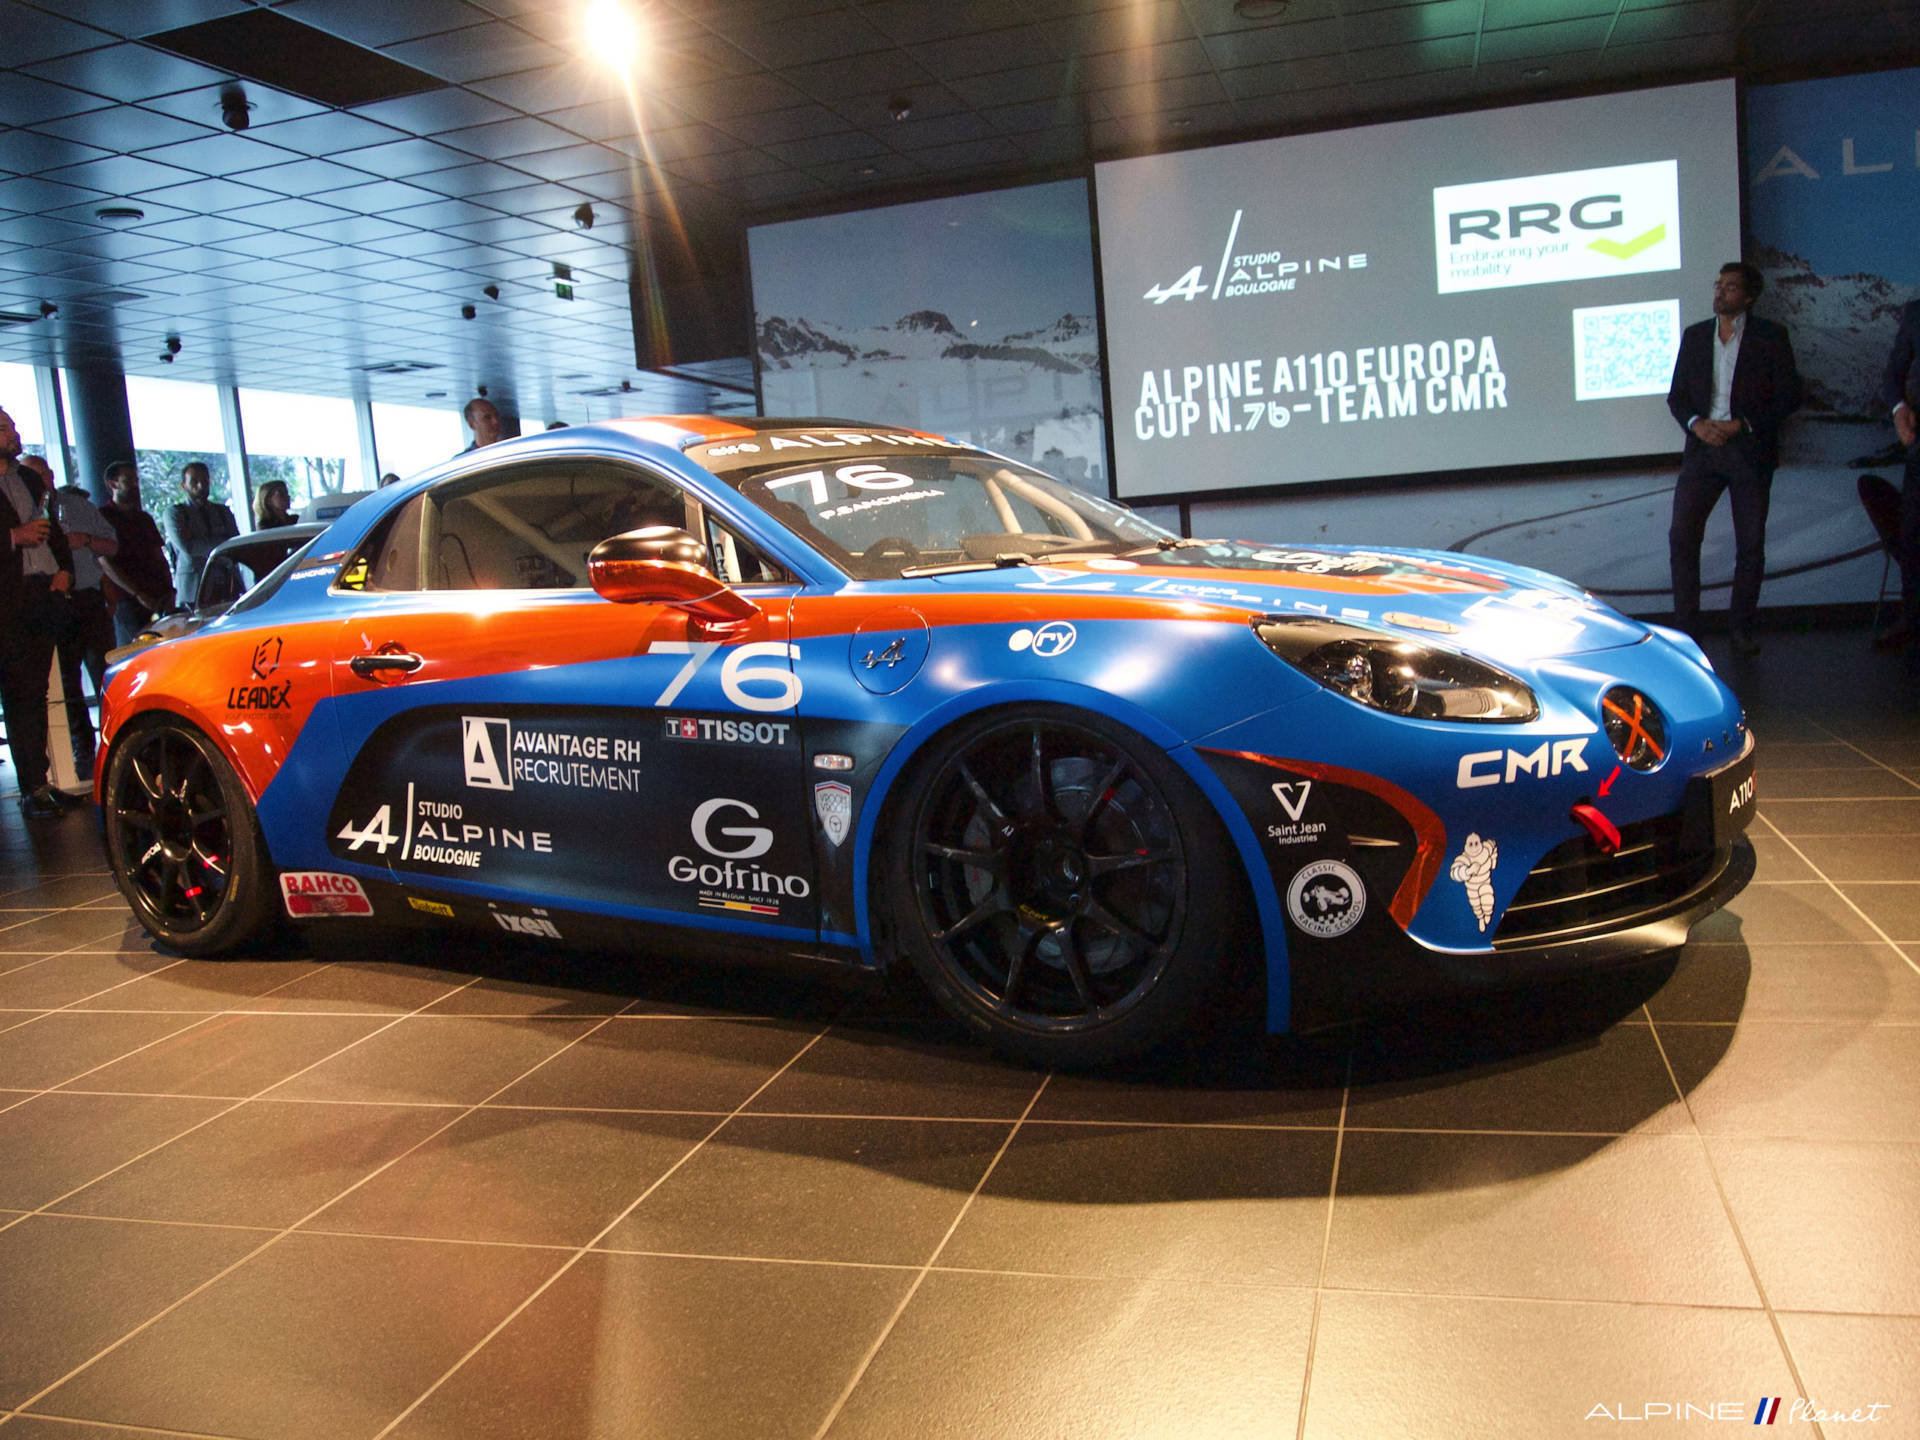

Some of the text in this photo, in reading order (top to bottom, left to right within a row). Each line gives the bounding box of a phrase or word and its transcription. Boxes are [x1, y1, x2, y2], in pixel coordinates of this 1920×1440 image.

[1754, 128, 1920, 184] AL
[1449, 194, 1623, 245] RRG
[1230, 253, 1367, 282] ALPINE
[1233, 252, 1281, 267] STUDIO
[1450, 242, 1570, 264] Embracing your
[1450, 263, 1512, 278] mobility
[1225, 278, 1296, 297] BOULOGNE
[1140, 336, 1501, 406] ALPINE A110 EUROPA
[1135, 400, 1201, 440] CUP
[1425, 371, 1508, 414] CMR
[764, 464, 915, 505] 76
[648, 641, 803, 711] 76
[227, 680, 292, 709] LEADEX
[513, 731, 641, 763] AVANTAGE RH
[698, 718, 790, 745] TISSOT
[513, 758, 640, 793] RECRUTEMENT
[1457, 738, 1589, 788] CMR
[418, 800, 463, 821] STUDIO
[1729, 775, 1754, 815] A110
[417, 821, 553, 853] ALPINE
[690, 797, 774, 859] G
[1268, 822, 1327, 837] Saint Jean
[1278, 834, 1318, 845] Industries
[413, 844, 481, 868] BOULOGNE
[285, 875, 358, 894] BAHCO
[668, 855, 810, 898] Gofrino
[1302, 865, 1337, 880] CLASSIC
[1298, 899, 1362, 934] RACING SCHOOL
